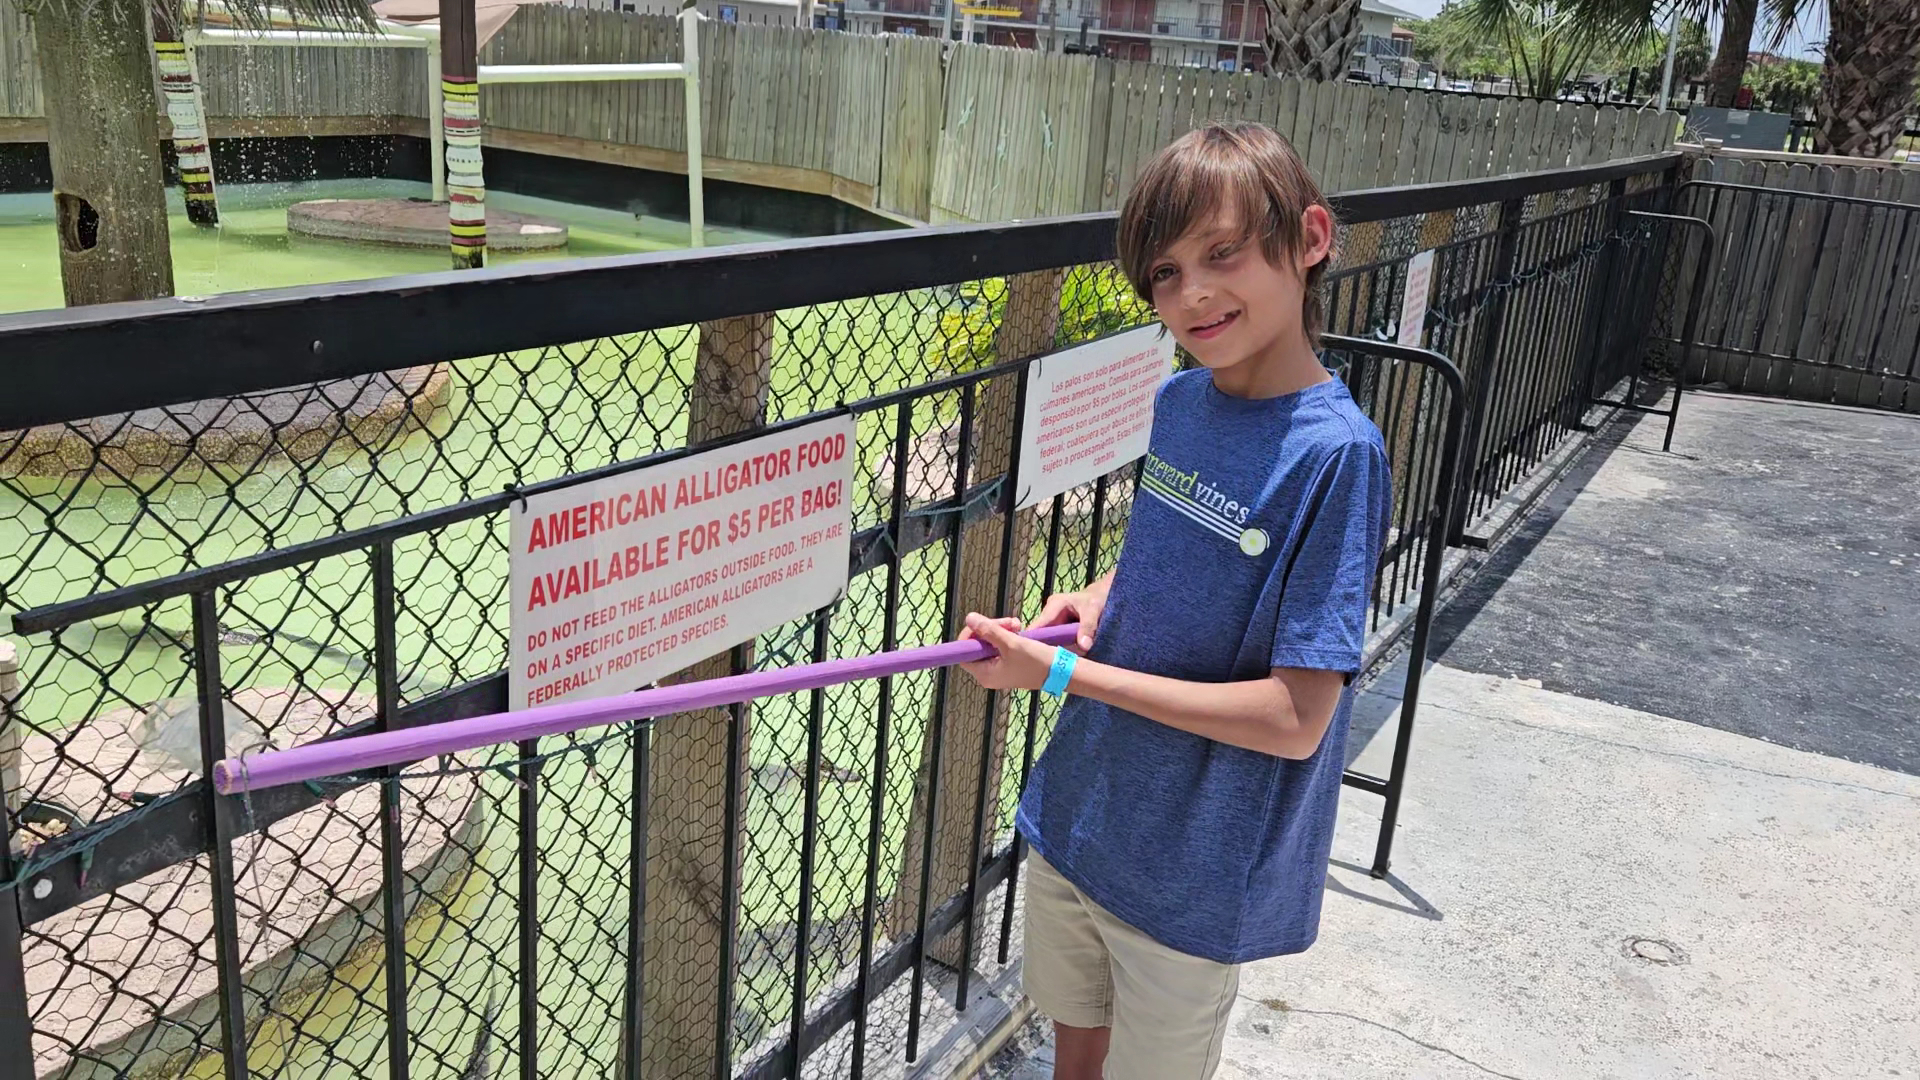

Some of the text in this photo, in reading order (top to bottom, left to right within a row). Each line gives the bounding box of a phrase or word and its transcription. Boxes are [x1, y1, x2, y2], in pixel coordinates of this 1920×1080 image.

[1052, 381, 1064, 393] Los
[1065, 376, 1082, 391] palos
[1083, 371, 1095, 382] son
[1095, 365, 1108, 378] solo
[1109, 361, 1121, 374] para
[1122, 352, 1146, 368] alimentar
[1081, 402, 1092, 415] por
[1093, 396, 1100, 408] $5
[1101, 394, 1111, 407] por
[1129, 383, 1139, 393] Los
[1109, 371, 1129, 387] Comida
[1130, 367, 1141, 380] para
[1036, 423, 1074, 445] americanos
[1076, 419, 1088, 430] son
[1089, 414, 1100, 425] una
[1101, 404, 1121, 420] especie
[1067, 429, 1099, 449] cualquiera
[527, 432, 846, 554] AMERICAN ALLIGATOR FOOD
[1042, 458, 1063, 473] sujeto
[1064, 456, 1069, 465] a
[1147, 447, 1250, 524] ineyard vines
[527, 479, 843, 612] AVAILABLE FOR $5 PER BAG!
[528, 522, 843, 653] DO NOT FEED THE ALLIGATORS OUTSIDE FOOD. THEY ARE
[527, 560, 814, 680] ON A SPECIFIC DIET. AMERICAN ALLIGATORS ARE A
[528, 614, 729, 707] FEDERALLY PROTECTED SPECIES.
